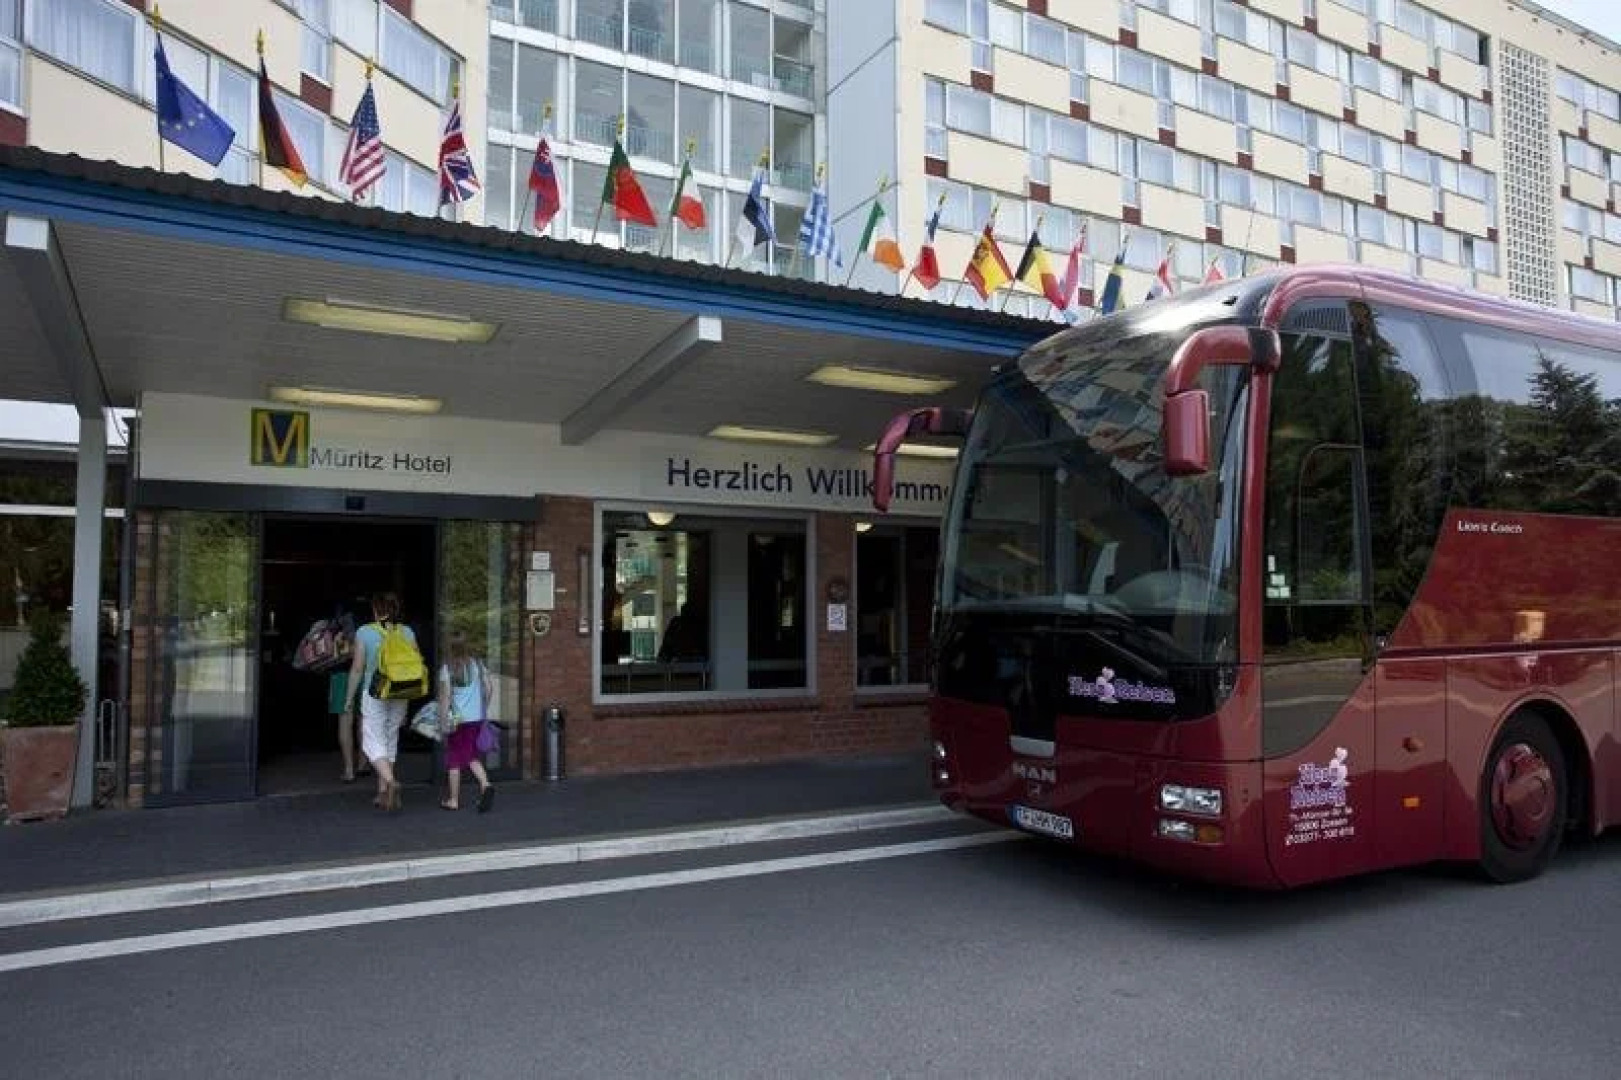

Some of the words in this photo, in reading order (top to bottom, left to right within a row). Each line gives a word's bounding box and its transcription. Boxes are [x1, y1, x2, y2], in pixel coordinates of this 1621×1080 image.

[311, 447, 384, 471] Müritz
[393, 453, 451, 473] Hotel
[667, 458, 793, 493] Herzlich
[806, 467, 950, 501] Willkmm
[1012, 761, 1056, 784] MAN
